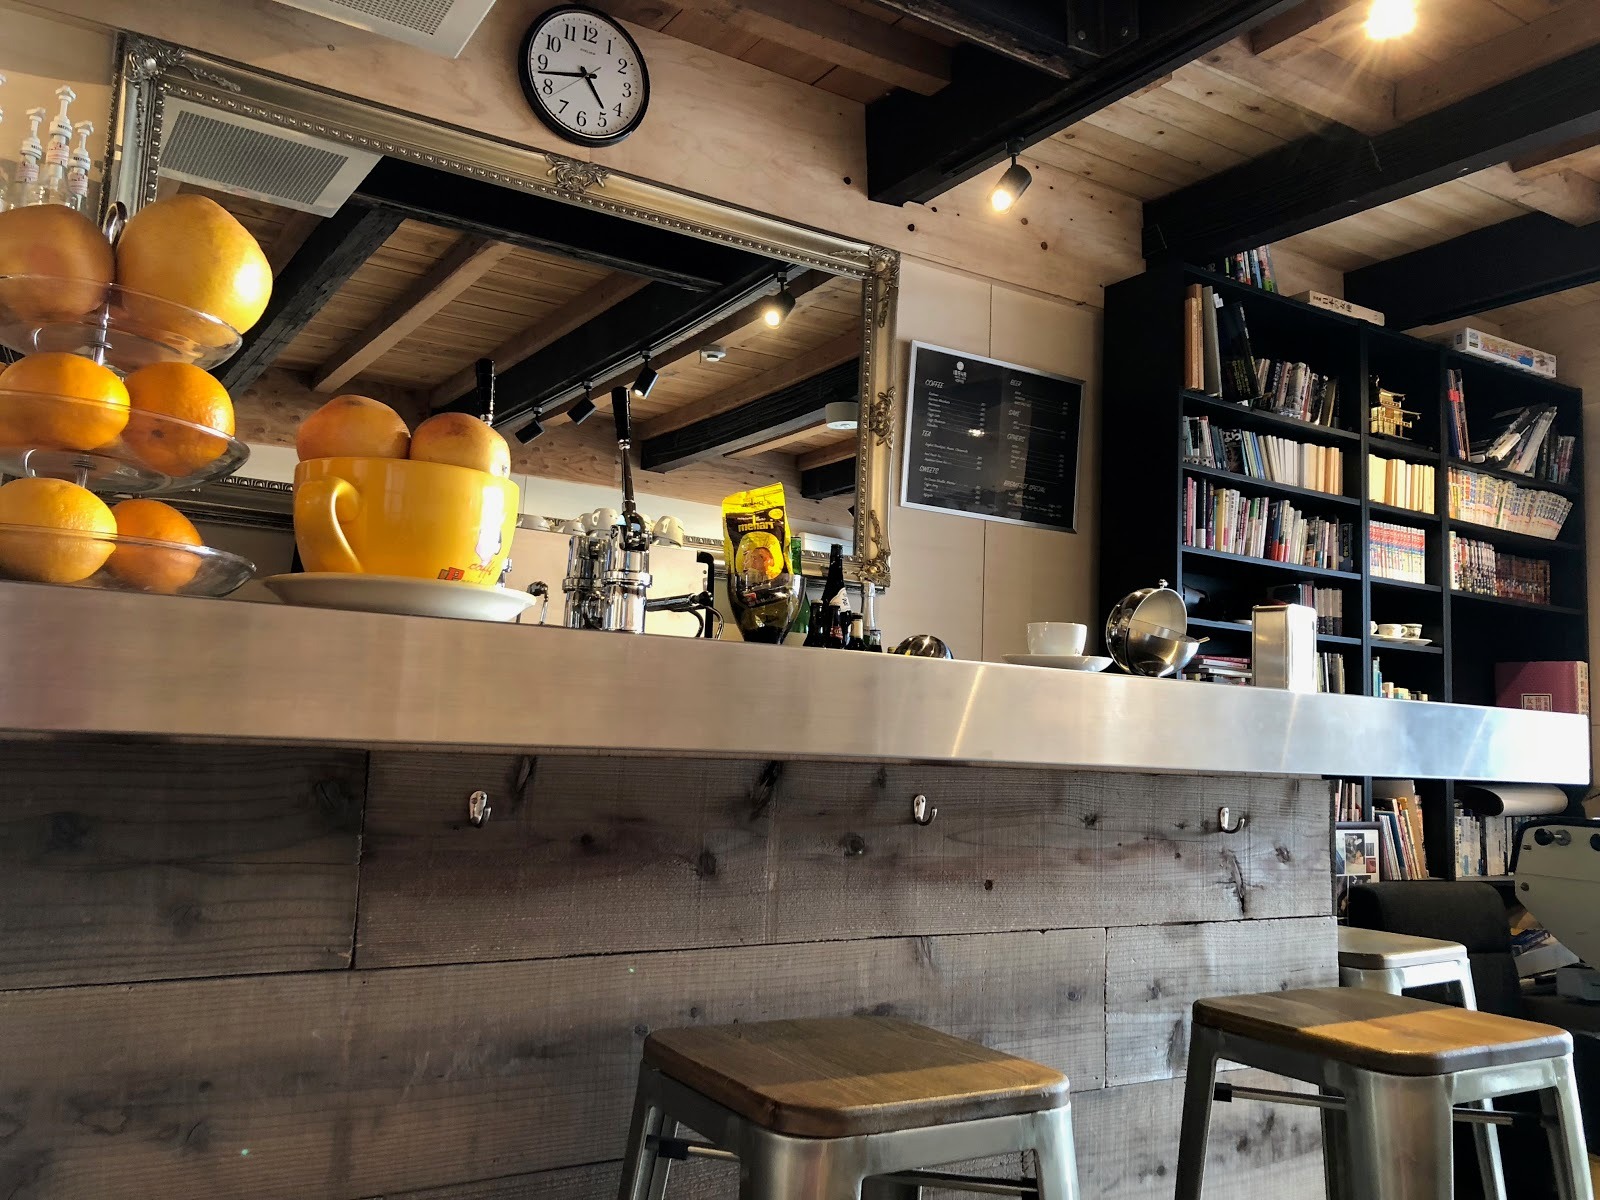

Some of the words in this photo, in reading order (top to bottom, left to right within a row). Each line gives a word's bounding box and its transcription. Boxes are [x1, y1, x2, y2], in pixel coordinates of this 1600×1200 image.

[563, 24, 577, 42] 11
[583, 25, 598, 44] 12
[545, 34, 561, 53] 10
[606, 39, 612, 55] 1
[537, 54, 548, 70] 9
[617, 58, 628, 75] 2
[542, 78, 553, 95] 8
[622, 82, 632, 98] 3
[559, 99, 570, 114] 7
[612, 102, 623, 117] 4
[576, 110, 587, 127] 6
[597, 111, 607, 128] 5
[924, 379, 945, 389] COFFEE
[921, 429, 931, 437] TEA
[918, 465, 939, 475] SWEETS
[738, 514, 775, 533] mehari
